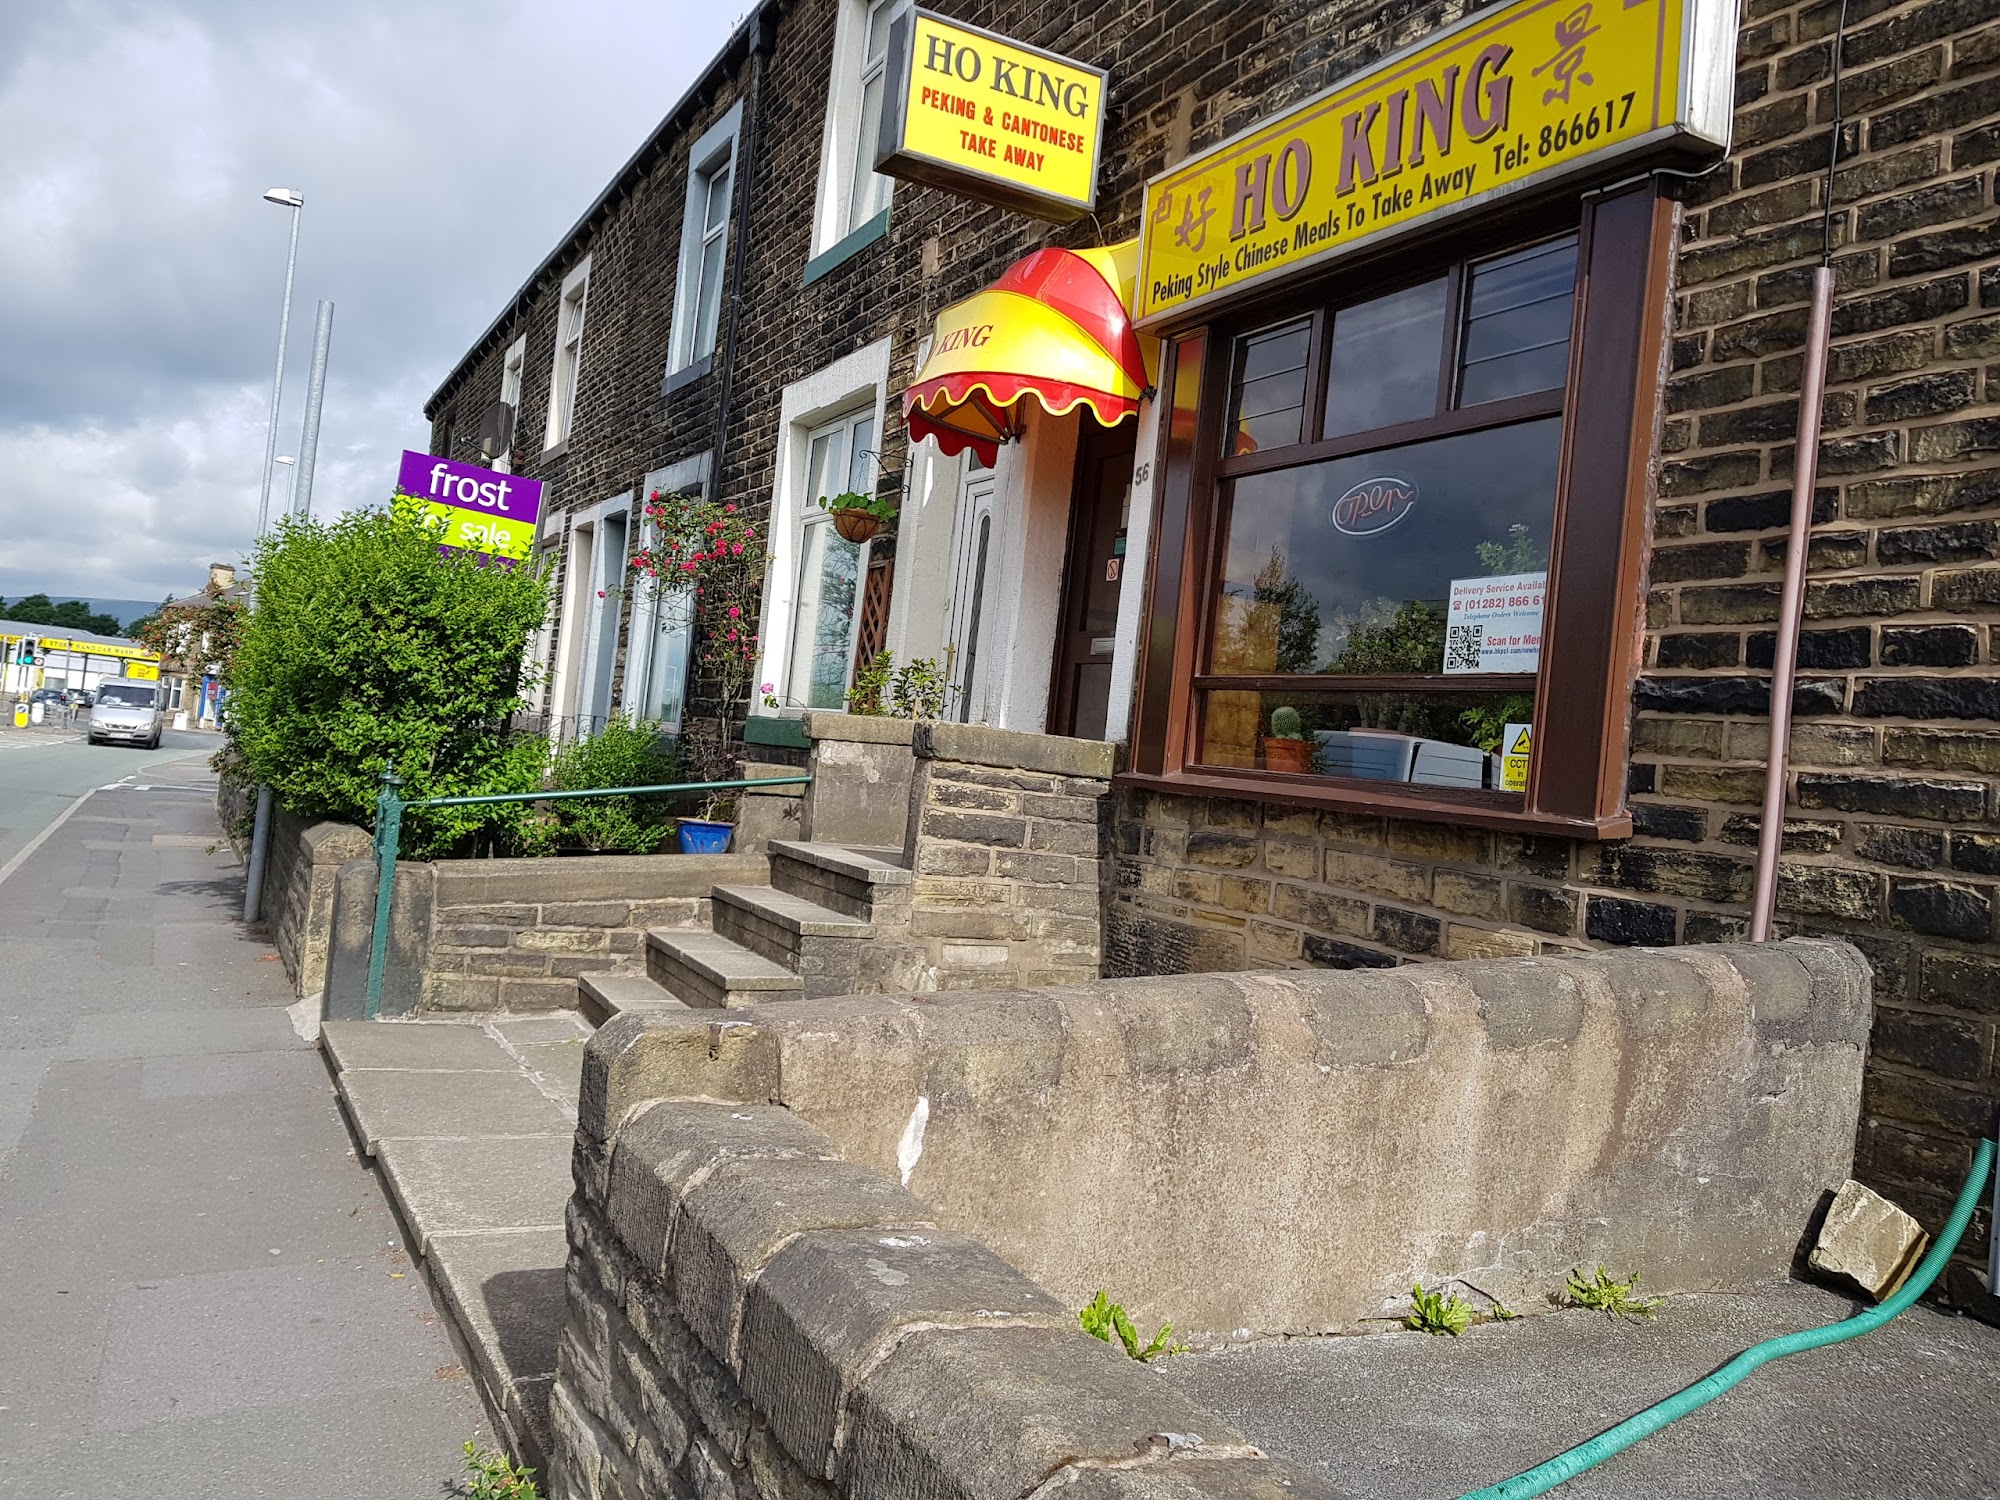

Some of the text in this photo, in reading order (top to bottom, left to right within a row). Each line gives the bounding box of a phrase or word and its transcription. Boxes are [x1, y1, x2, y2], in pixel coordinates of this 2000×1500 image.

[924, 34, 1088, 119] HO KING
[921, 86, 1084, 153] PEKING & CANTONESE
[960, 130, 1045, 172] TAKE AWAY
[1229, 43, 1513, 242] HO KING
[1152, 91, 1636, 305] Peking Style Chinese Meals To Take Away Tel: 866617
[935, 325, 994, 357] KING
[429, 463, 512, 511] frost
[1135, 461, 1150, 487] 56
[459, 522, 511, 548] sale
[1453, 581, 1547, 596] Delivery Service Availab
[1465, 595, 1545, 611] (01282) 866 61
[1463, 613, 1490, 621] Telephone
[1487, 635, 1541, 646] Scan for Men
[1510, 759, 1527, 769] CCT
